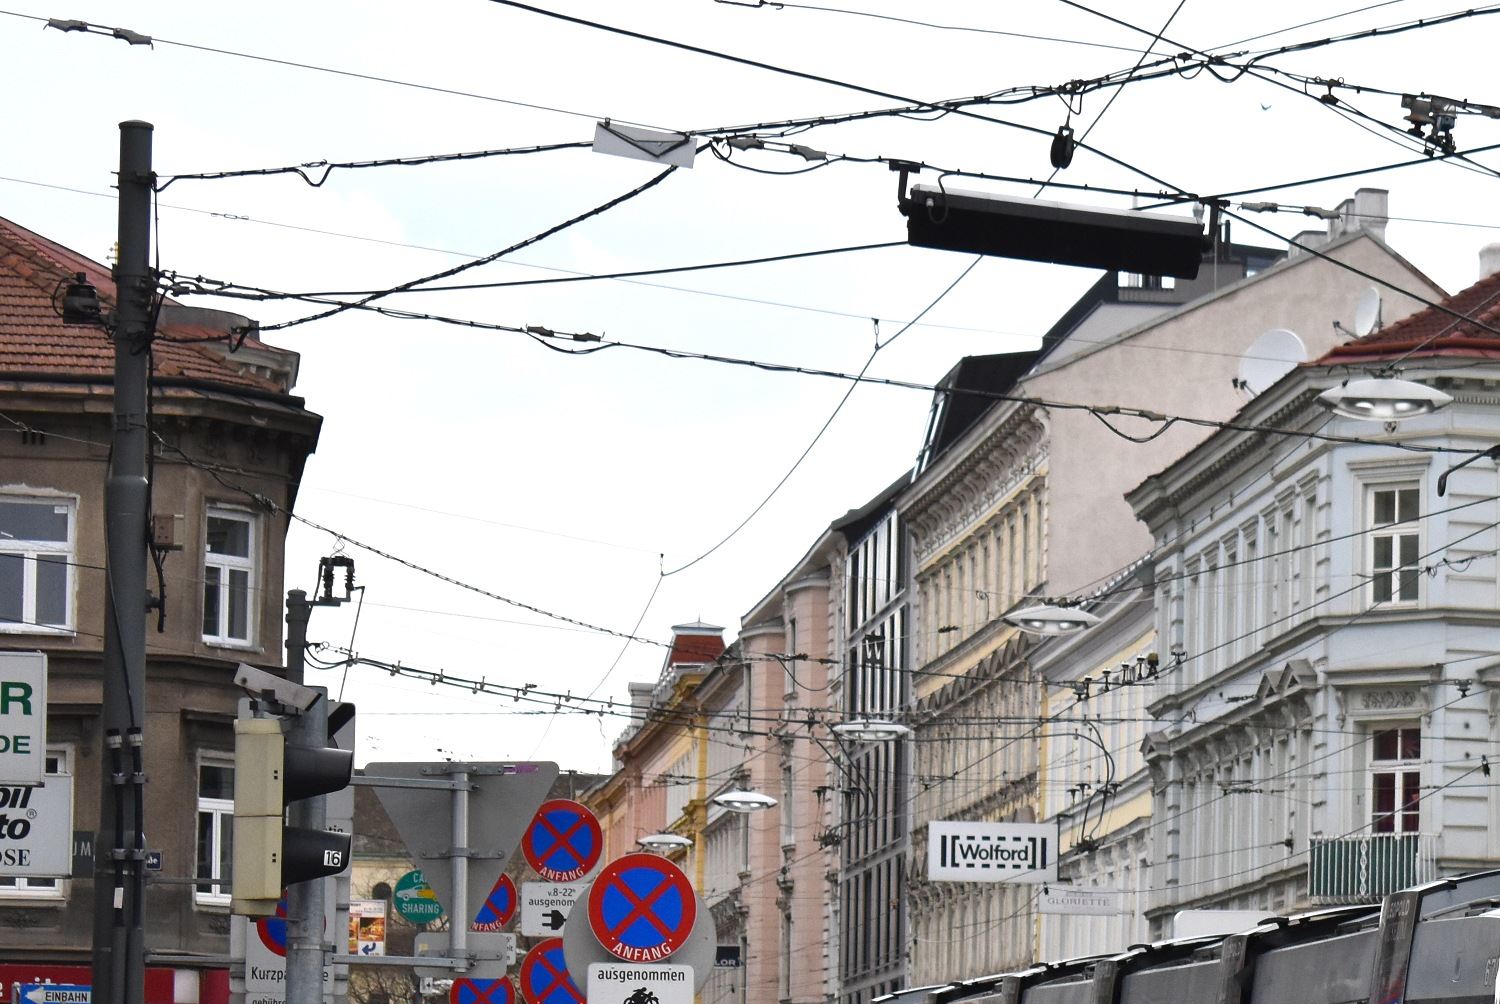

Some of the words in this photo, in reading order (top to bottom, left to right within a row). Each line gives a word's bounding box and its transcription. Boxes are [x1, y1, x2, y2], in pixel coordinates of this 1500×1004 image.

[325, 851, 341, 867] 16
[959, 844, 1029, 861] Wolford
[539, 866, 584, 881] ANFANG
[402, 903, 440, 914] SHARING
[612, 941, 672, 961] ANFANG
[597, 969, 685, 981] ausgenommen
[45, 991, 88, 1002] EINBAHN
